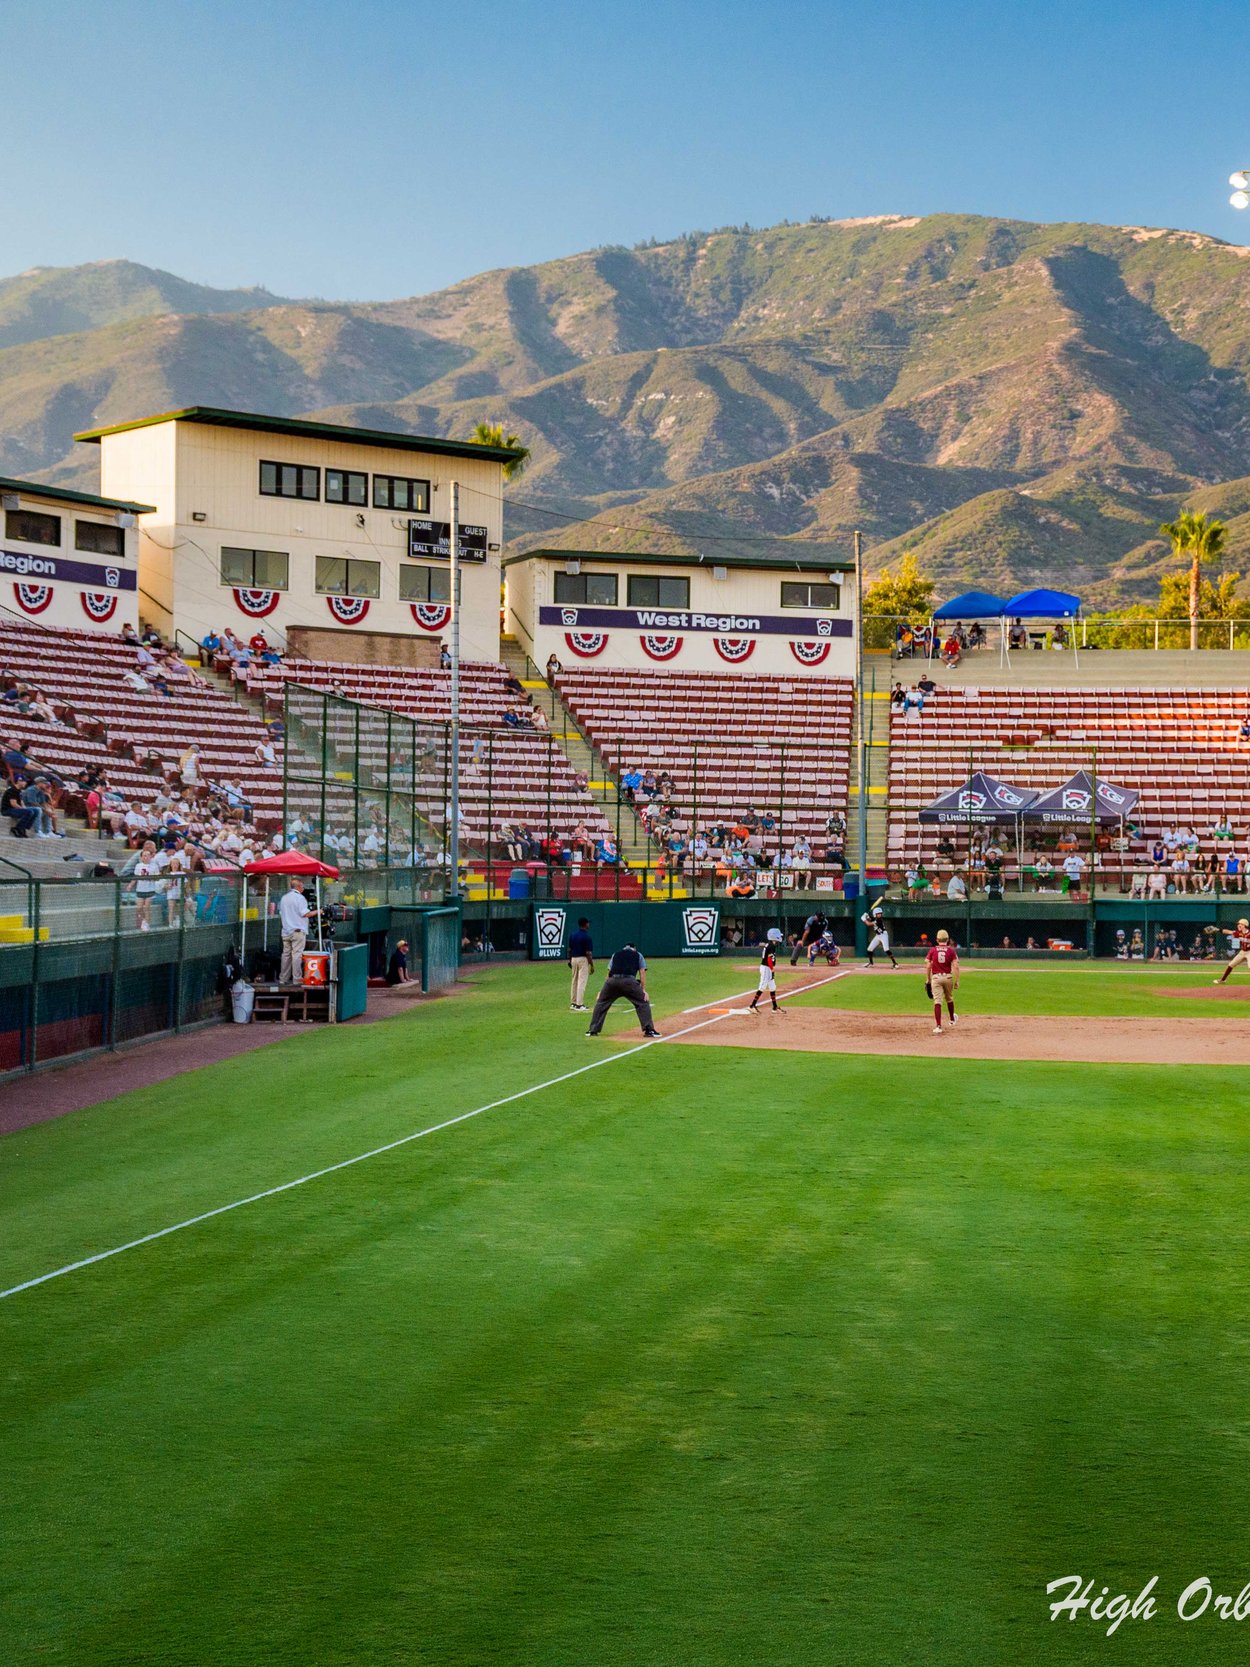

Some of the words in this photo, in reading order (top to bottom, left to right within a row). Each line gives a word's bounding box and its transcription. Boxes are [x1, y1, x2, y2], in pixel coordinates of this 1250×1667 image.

[412, 521, 432, 530] HOME
[465, 526, 487, 536] GUEST
[413, 544, 429, 553] BALL
[636, 611, 689, 627] West
[691, 614, 760, 632] Region
[1050, 814, 1072, 822] Little
[1071, 814, 1101, 823] Leage
[308, 960, 318, 971] G
